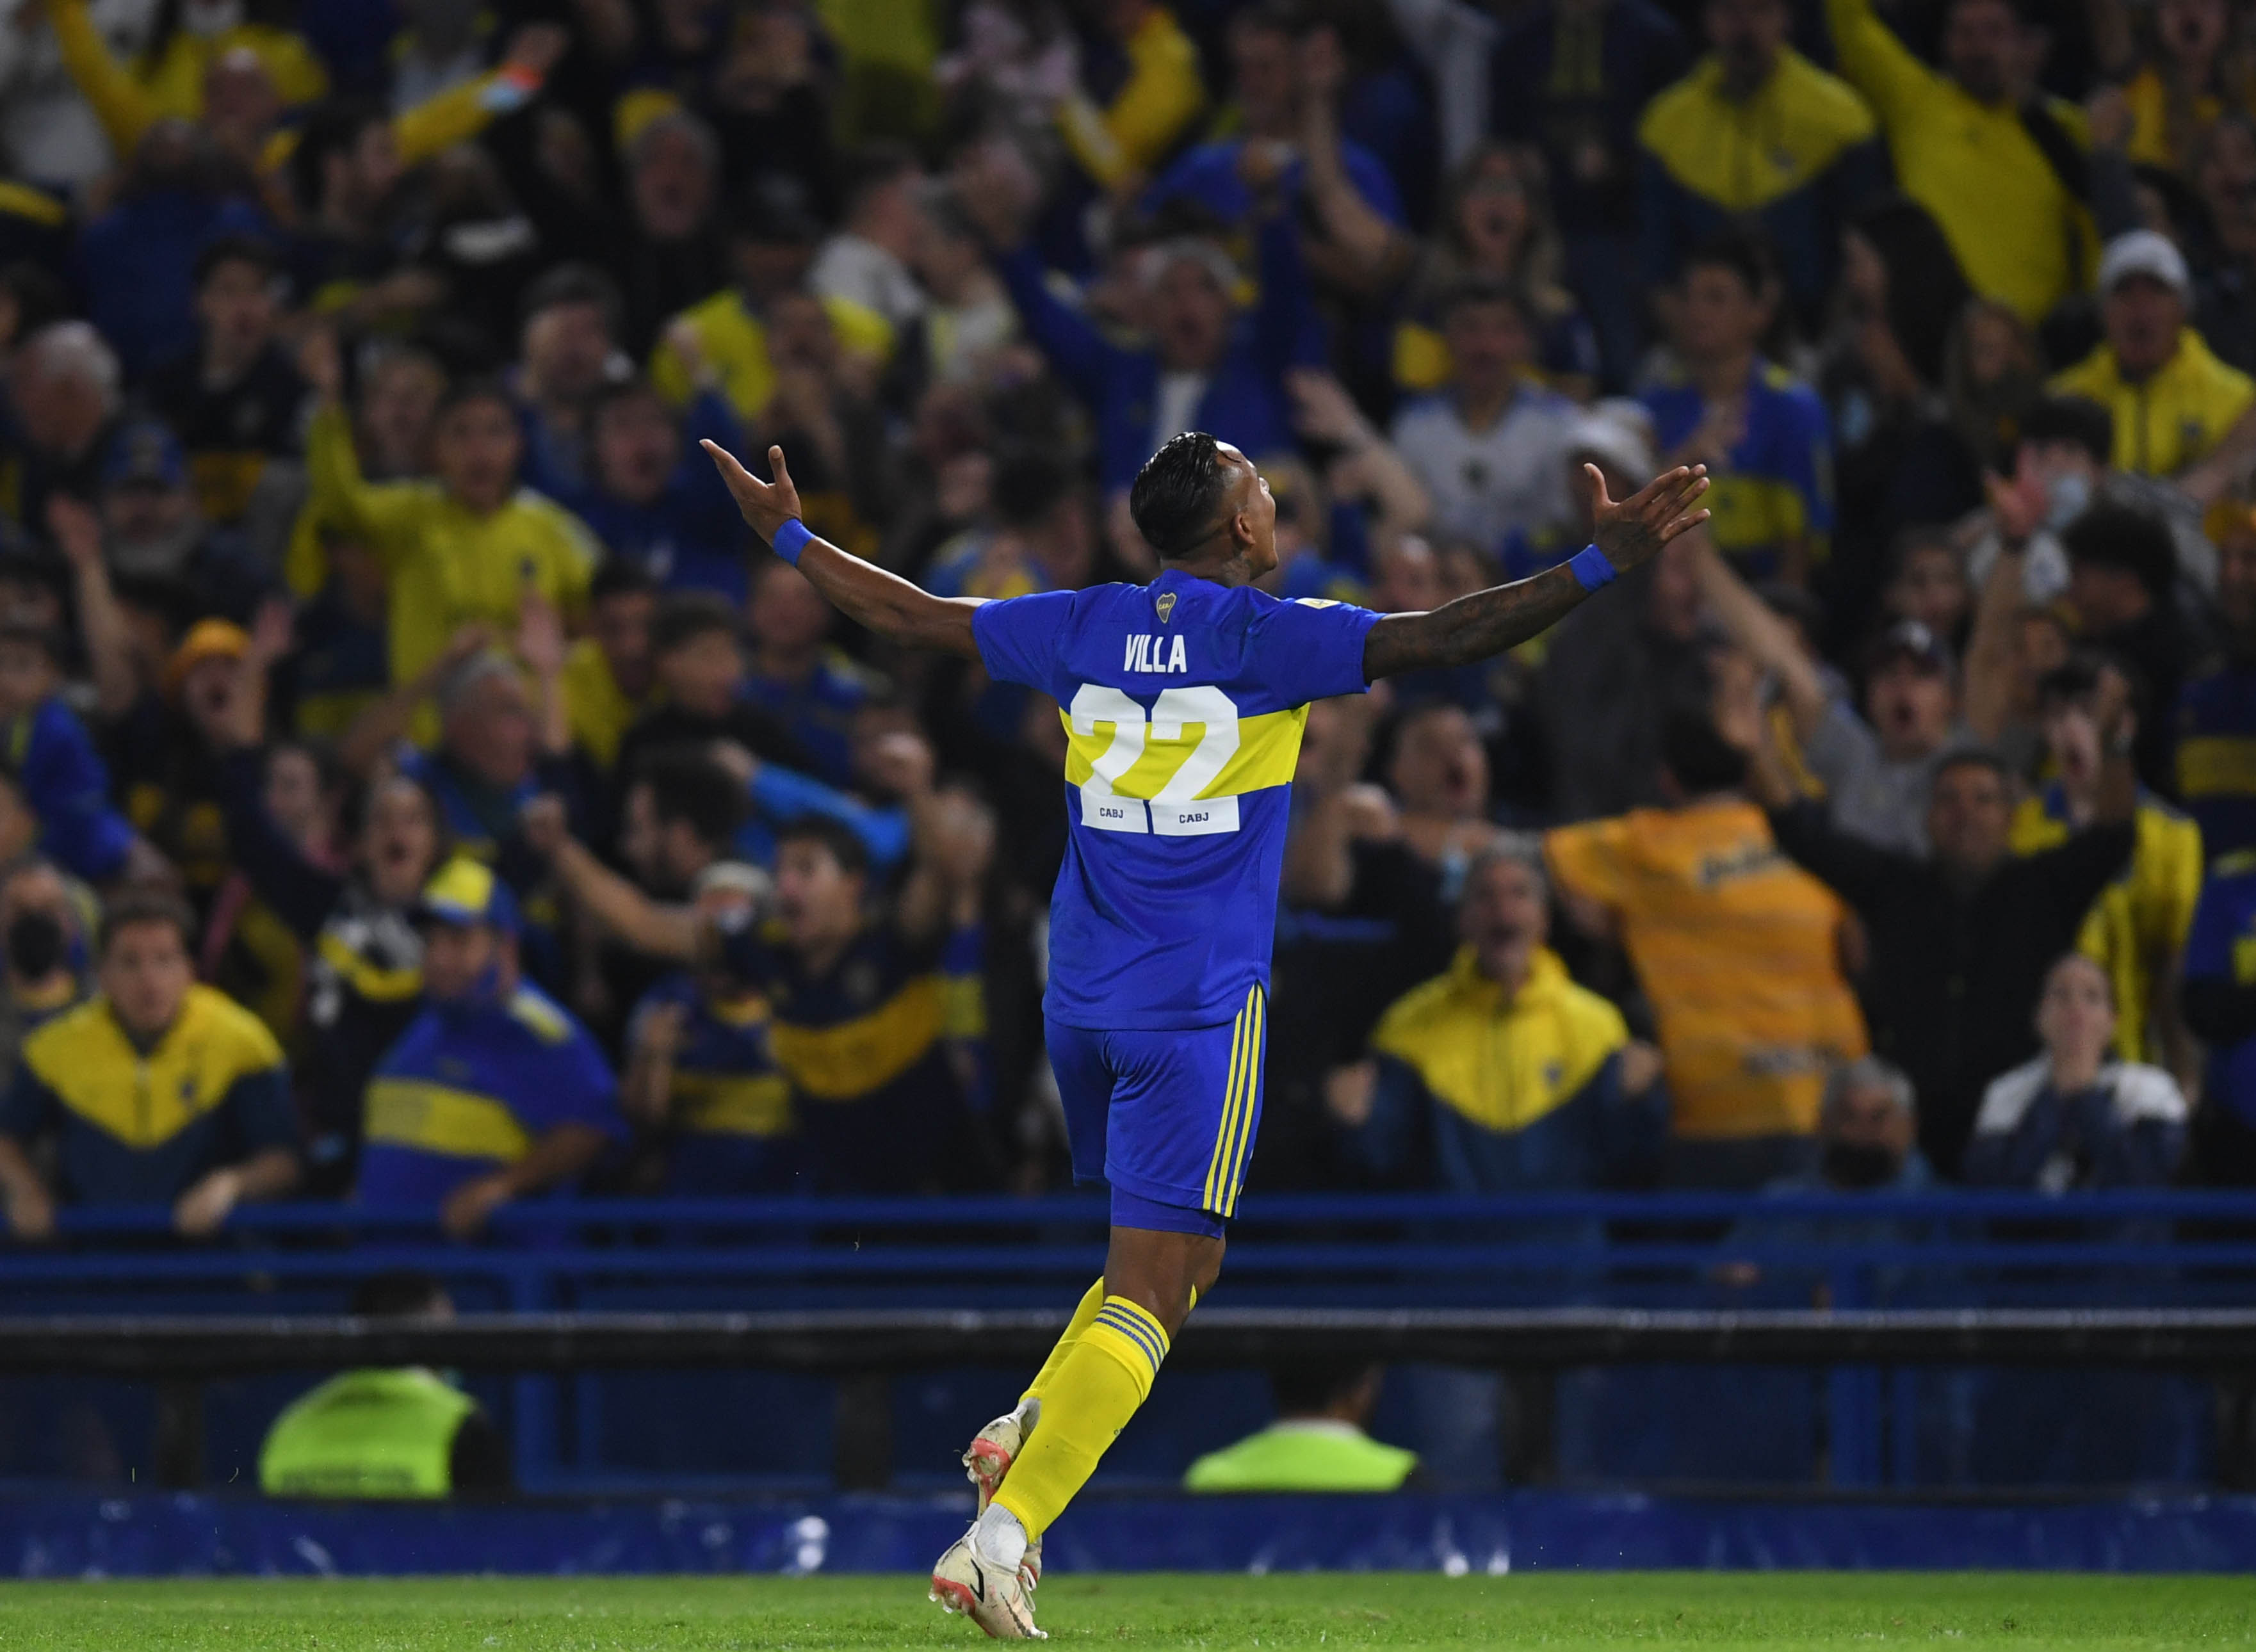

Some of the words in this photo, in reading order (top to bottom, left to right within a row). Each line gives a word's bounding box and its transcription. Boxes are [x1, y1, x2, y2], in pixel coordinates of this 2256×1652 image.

[1124, 634, 1187, 673] VILLA
[1070, 683, 1240, 836] 22
[1100, 807, 1124, 819] CABJ
[1179, 812, 1209, 824] CABJ
